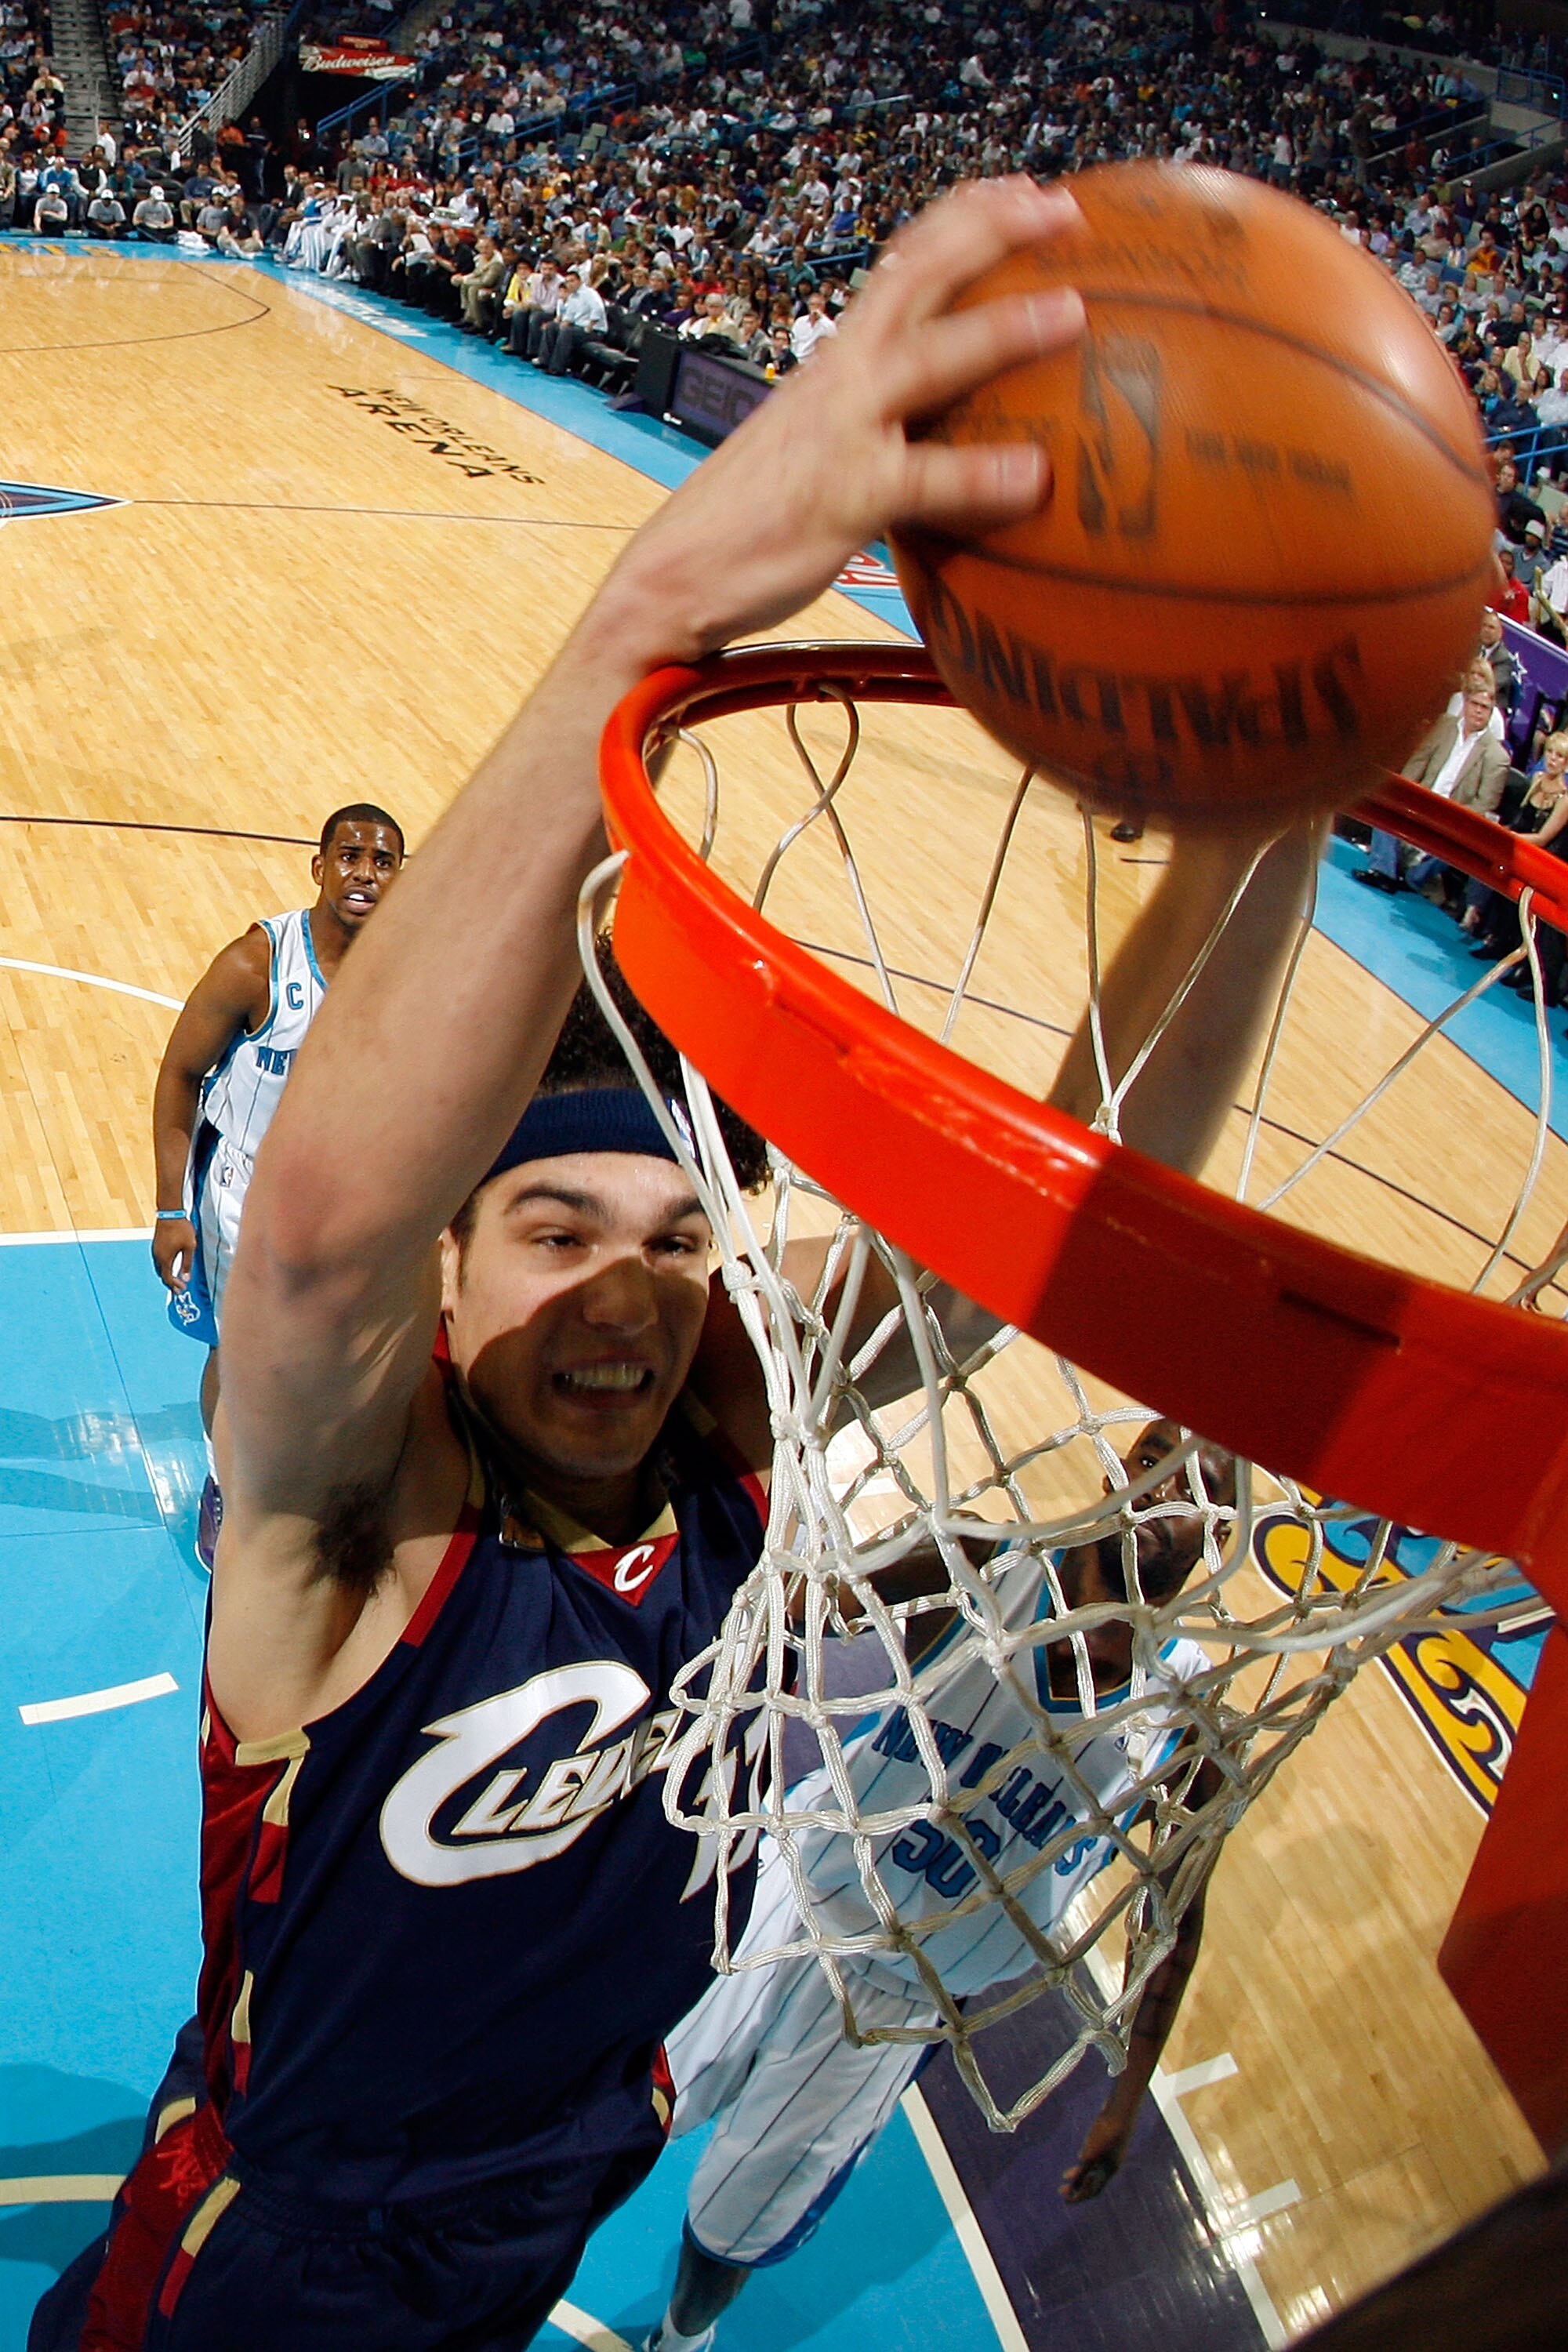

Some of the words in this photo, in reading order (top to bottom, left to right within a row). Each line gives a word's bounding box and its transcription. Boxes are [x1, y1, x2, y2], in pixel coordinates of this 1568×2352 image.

[302, 53, 395, 71] Budweiser
[680, 365, 756, 428] GEIC
[326, 384, 495, 478] ARENA
[420, 417, 546, 484] ORLEANS
[930, 576, 1363, 754] SPALDING
[285, 982, 304, 1010] C
[256, 1046, 297, 1076] NE
[615, 1544, 655, 1592] C
